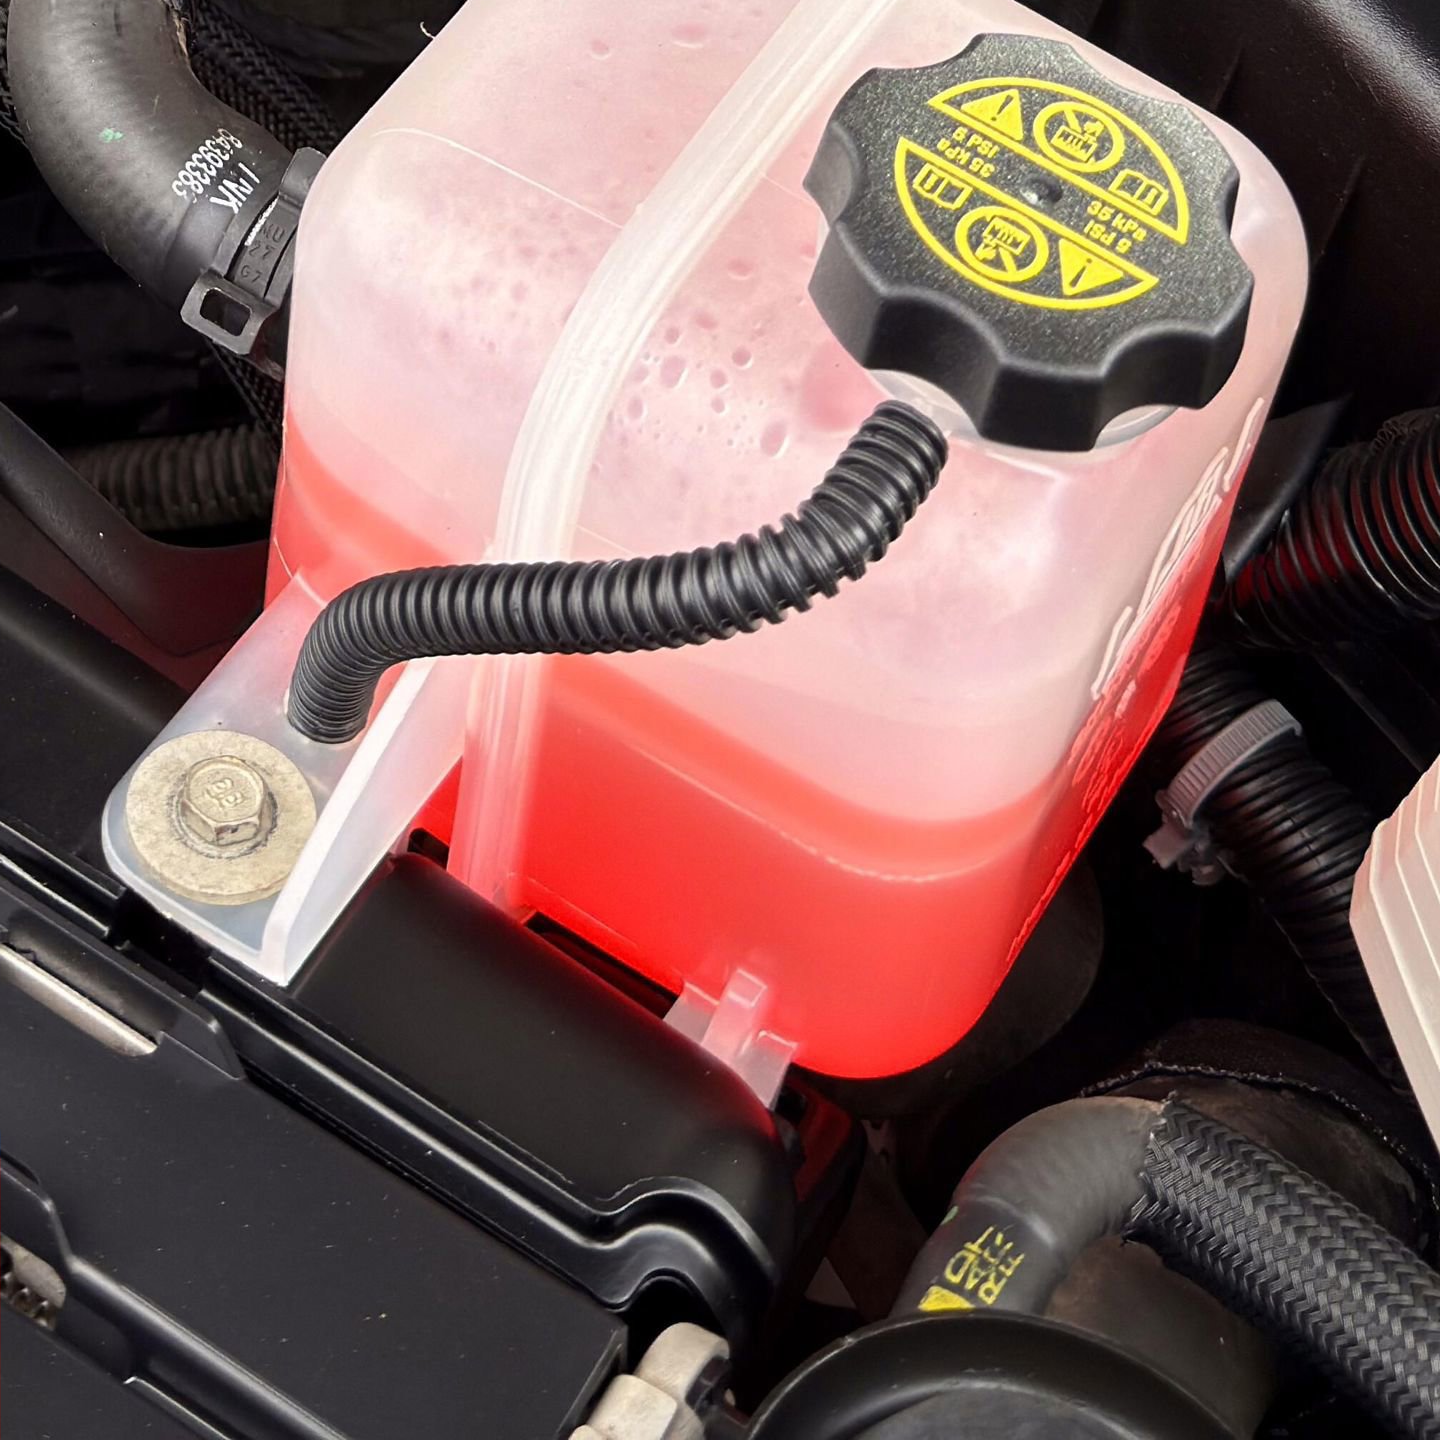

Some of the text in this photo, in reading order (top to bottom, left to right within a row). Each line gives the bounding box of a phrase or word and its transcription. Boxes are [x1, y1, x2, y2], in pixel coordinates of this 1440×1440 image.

[967, 134, 1001, 158] PSI
[1084, 220, 1118, 246] PSI
[1111, 212, 1148, 242] kPa
[944, 1249, 1008, 1305] RAD
